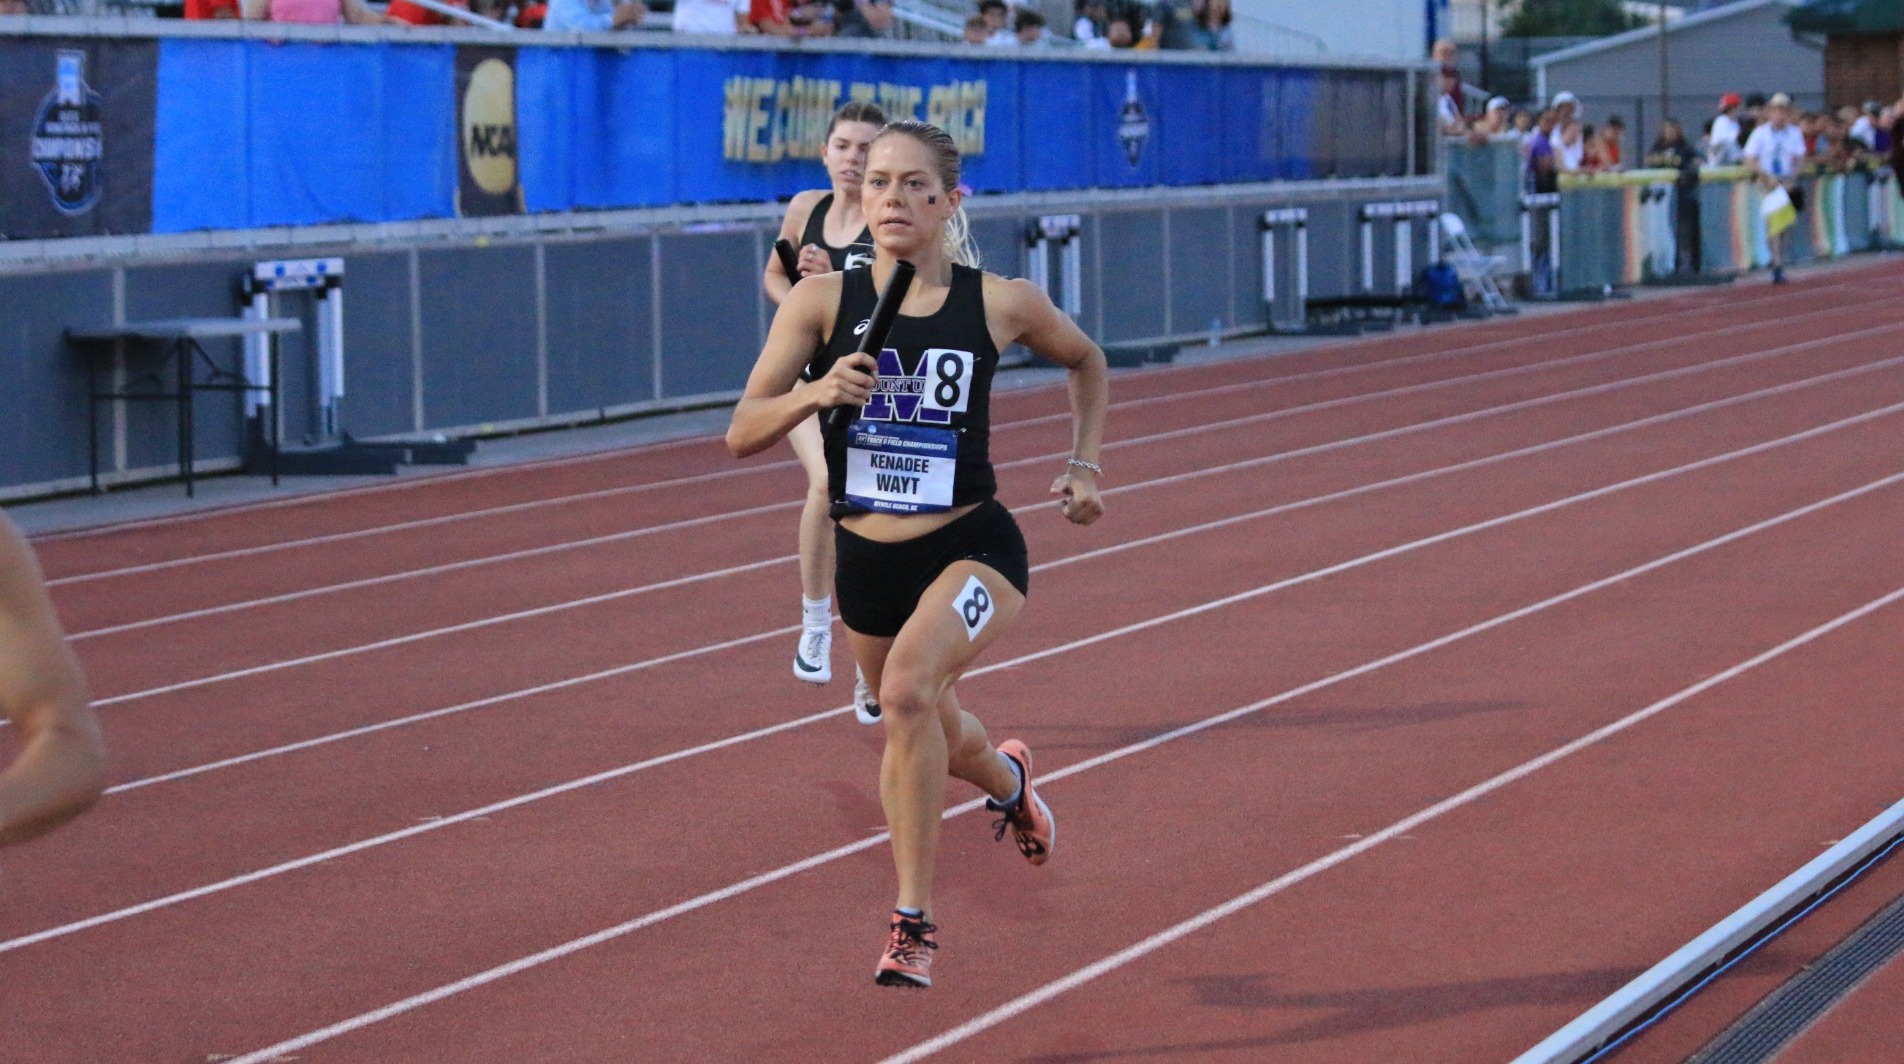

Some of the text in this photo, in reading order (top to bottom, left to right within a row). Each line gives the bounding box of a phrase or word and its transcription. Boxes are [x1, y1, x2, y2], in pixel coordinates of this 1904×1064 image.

[870, 378, 911, 392] OUNT
[934, 352, 964, 407] 8
[866, 436, 883, 445] TRACK
[887, 439, 903, 447] FIELD
[903, 440, 948, 451] CHAMPIONSHIPS
[870, 453, 930, 473] KENADEE
[876, 473, 920, 495] WAYT
[963, 586, 989, 628] 8
